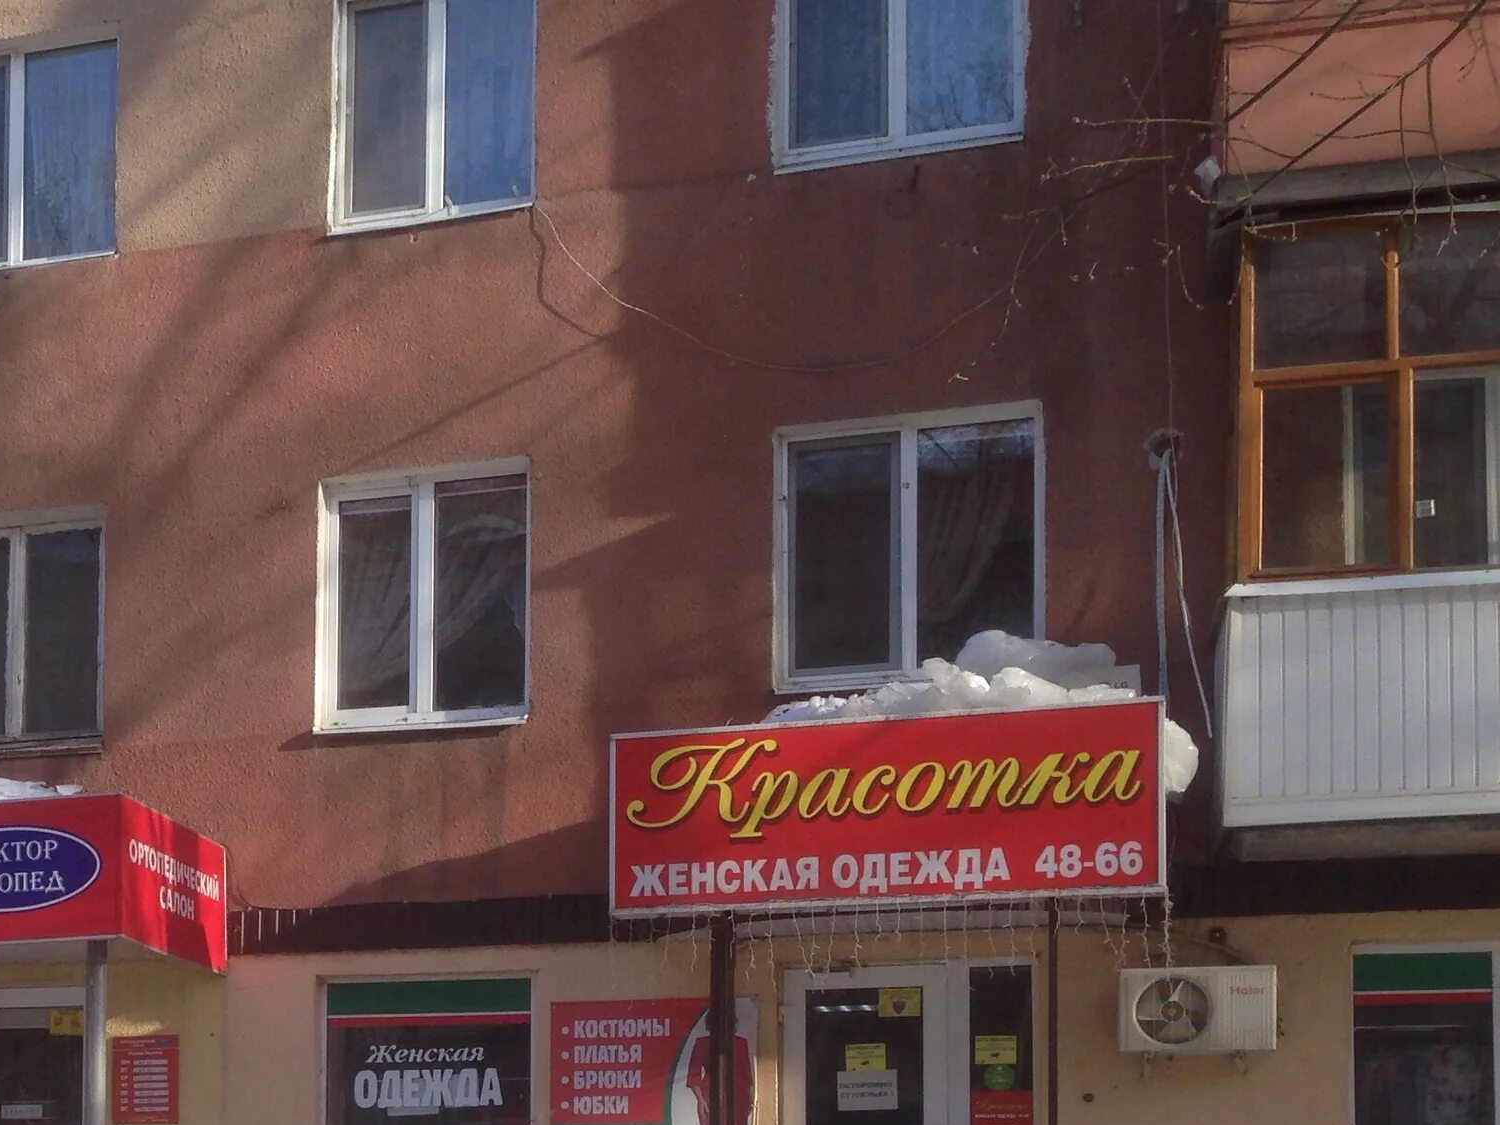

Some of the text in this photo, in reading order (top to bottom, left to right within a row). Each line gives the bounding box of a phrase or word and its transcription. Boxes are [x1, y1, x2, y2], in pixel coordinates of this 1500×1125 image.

[626, 737, 1142, 838] Красотка
[128, 837, 221, 902] ОРТОПЕДИЧЕСКИЙ
[629, 840, 1143, 898] ЖЕНСКАЯ ОДЕЖДА 48-66
[159, 885, 196, 921] САЛОН
[574, 1018, 671, 1038] КОСТЮМЫ
[365, 1045, 485, 1064] Женская
[573, 1044, 642, 1064] ПЛАТЬЯ
[354, 1068, 503, 1109] ОДЕЖДА
[573, 1070, 642, 1089] БРЮКИ
[573, 1096, 629, 1115] ЮБКИ
